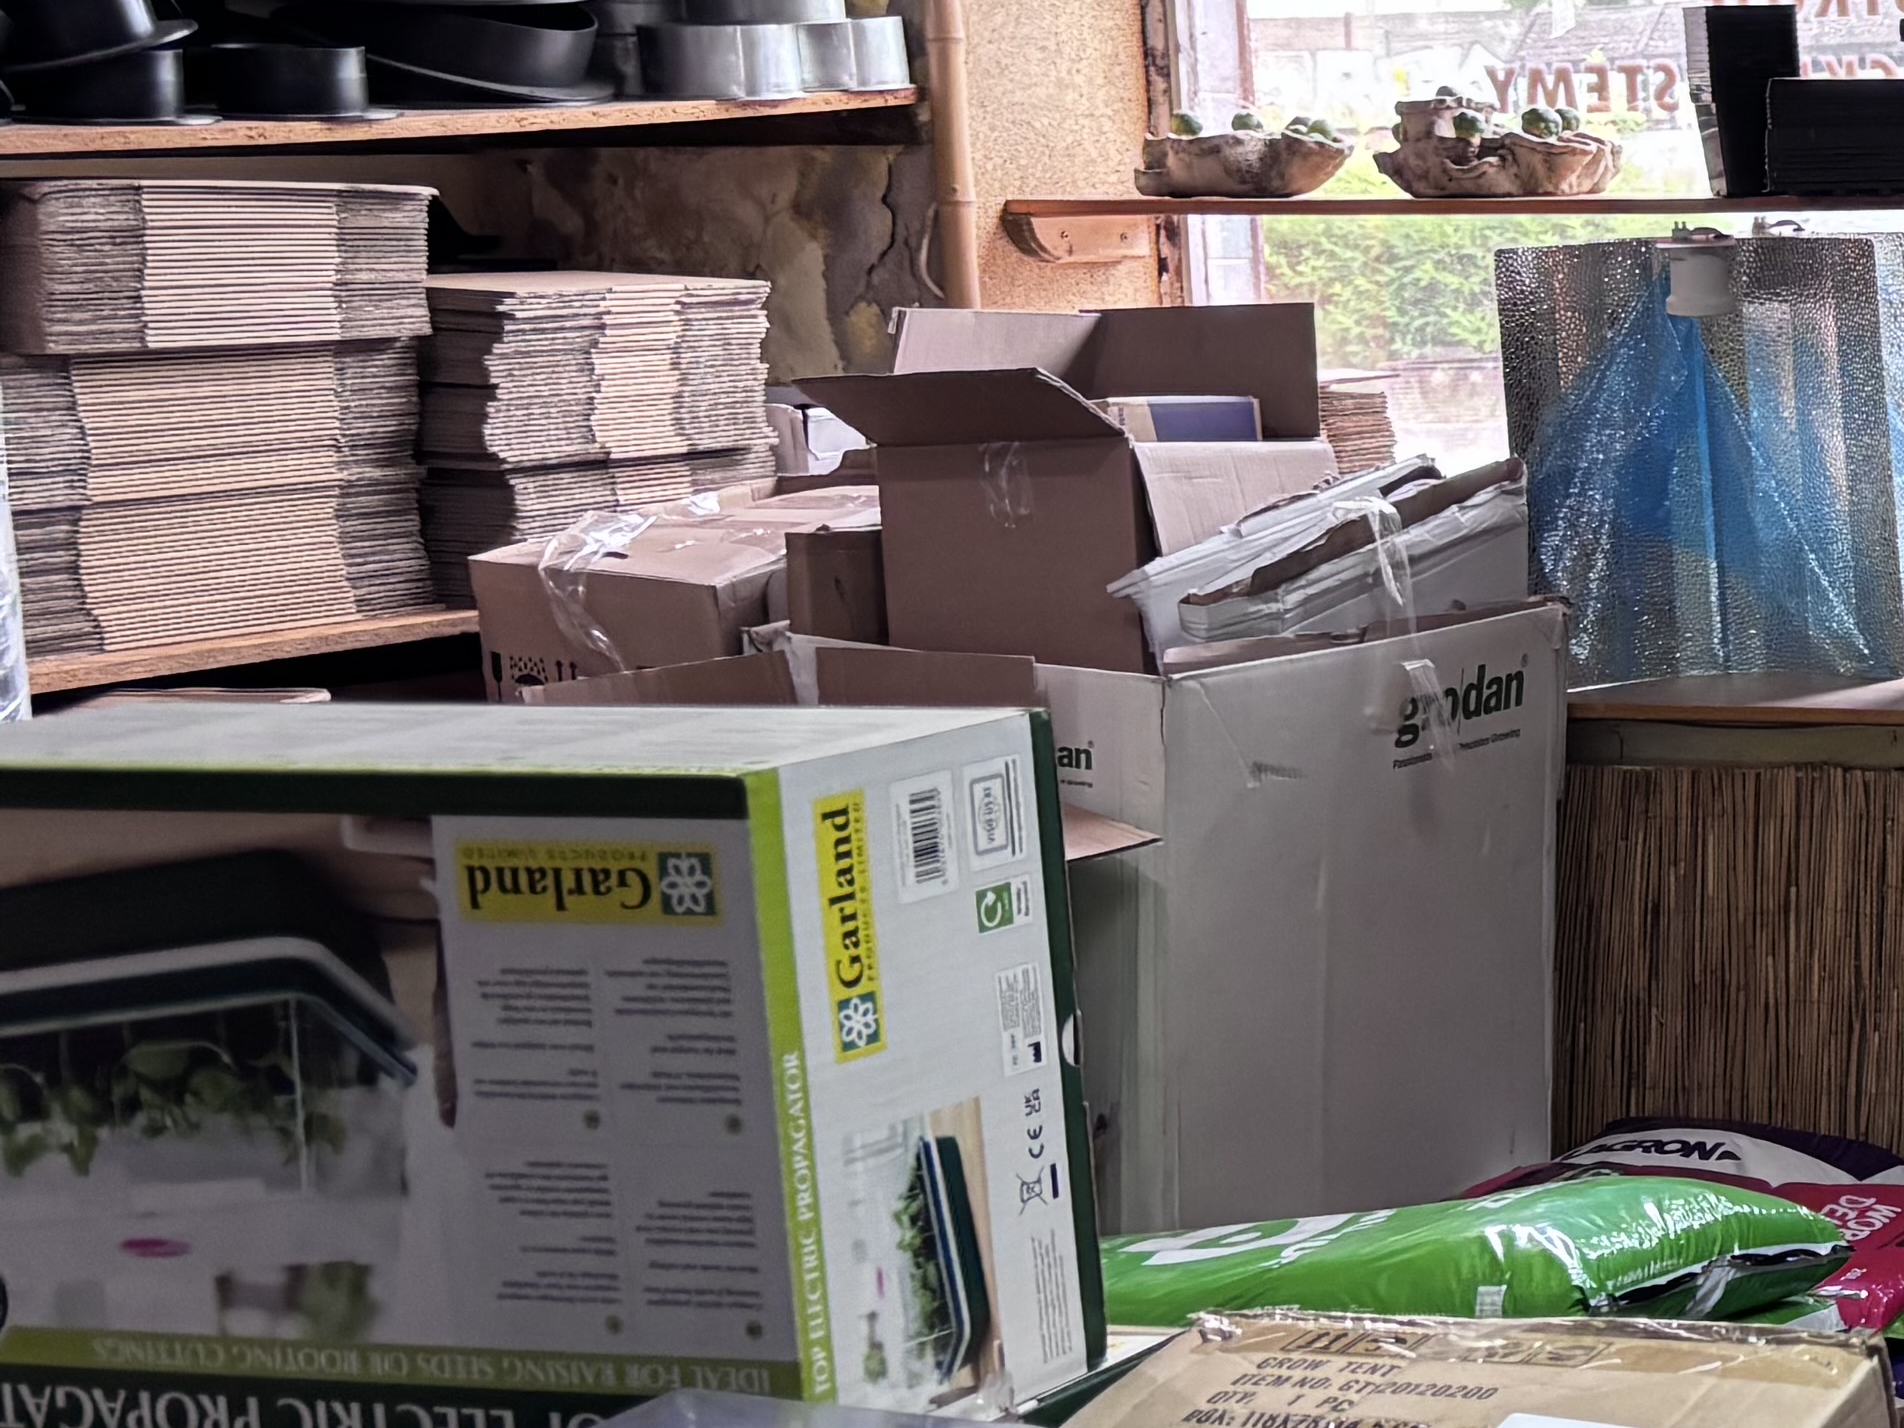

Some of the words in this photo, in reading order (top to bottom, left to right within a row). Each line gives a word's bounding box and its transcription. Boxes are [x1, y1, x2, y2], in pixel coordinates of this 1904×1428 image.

[465, 861, 652, 912] Garland
[821, 803, 864, 989] Garland
[781, 1049, 815, 1220] PROPAGATOR
[798, 1227, 827, 1339] ELECTRIC
[1230, 1373, 1286, 1388] ITEM
[1255, 1356, 1330, 1370] GROW
[1338, 1361, 1404, 1377] TENT
